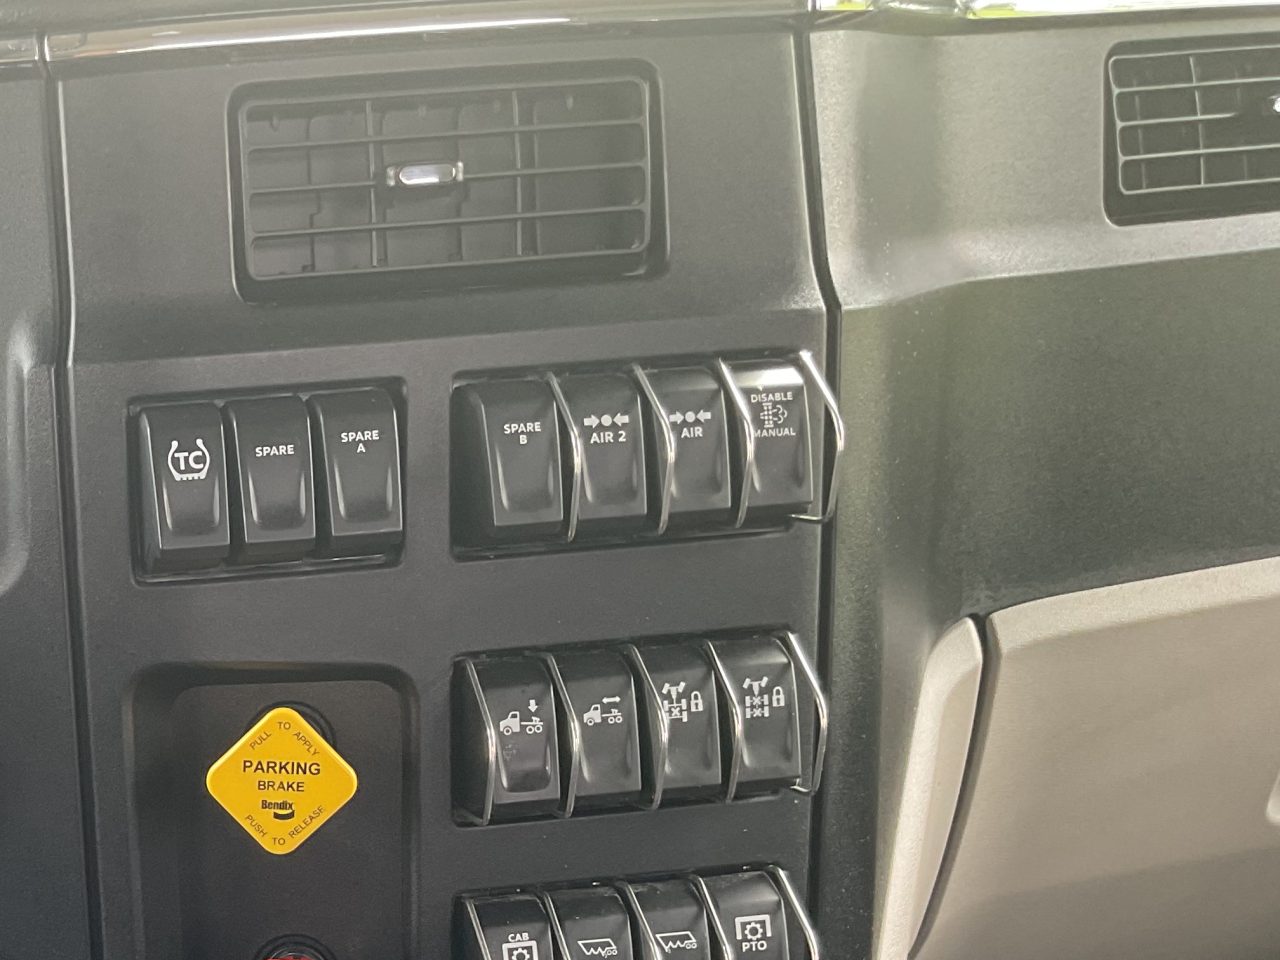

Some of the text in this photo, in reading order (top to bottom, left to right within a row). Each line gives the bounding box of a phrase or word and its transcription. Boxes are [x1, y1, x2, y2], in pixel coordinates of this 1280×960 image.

[750, 391, 793, 402] DISABLE
[503, 422, 542, 434] SPARE
[680, 427, 703, 439] AIR
[753, 427, 796, 438] MANUAL
[340, 430, 380, 442] SPARE
[519, 435, 528, 445] B
[590, 430, 627, 444] AIR 2
[255, 444, 295, 457] SPARE
[356, 443, 366, 453] A
[174, 451, 204, 471] TC
[249, 721, 320, 756] PULL TO APPLY
[242, 759, 321, 776] PARKING
[257, 780, 305, 792] BRAKE
[261, 799, 294, 811] Bendix
[245, 805, 326, 846] PUSH TO RELEASE
[508, 932, 530, 943] CAB
[741, 939, 768, 953] PTO
